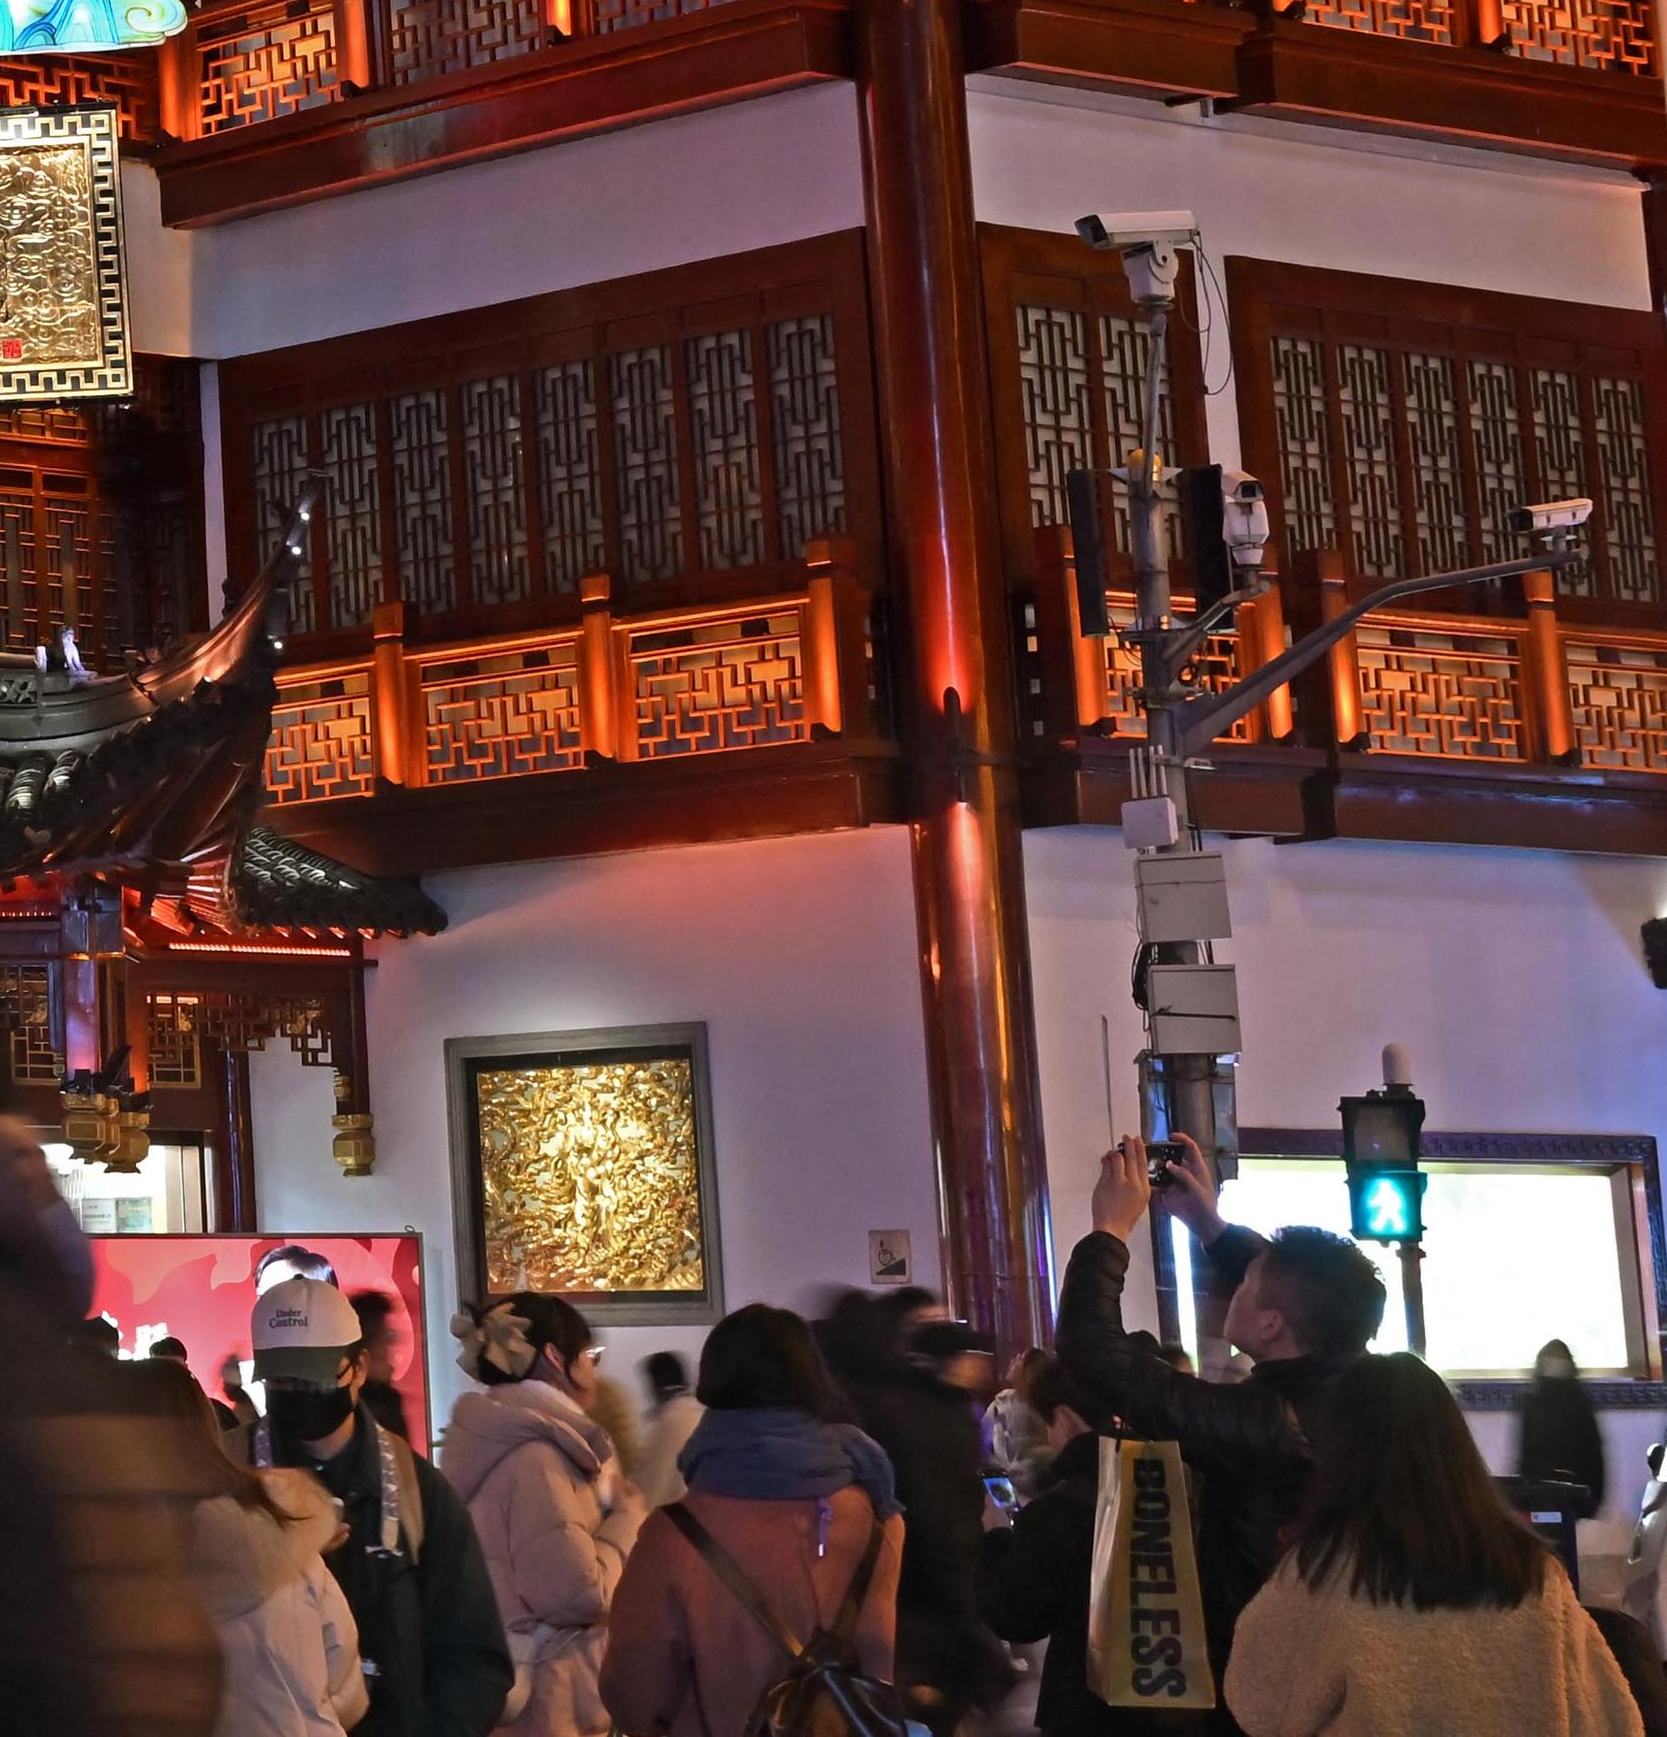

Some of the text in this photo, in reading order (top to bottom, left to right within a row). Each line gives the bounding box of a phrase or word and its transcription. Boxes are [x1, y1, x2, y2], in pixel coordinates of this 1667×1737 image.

[276, 1308, 303, 1318] Under
[268, 1316, 308, 1329] Control
[1129, 1458, 1186, 1697] BONELESS
